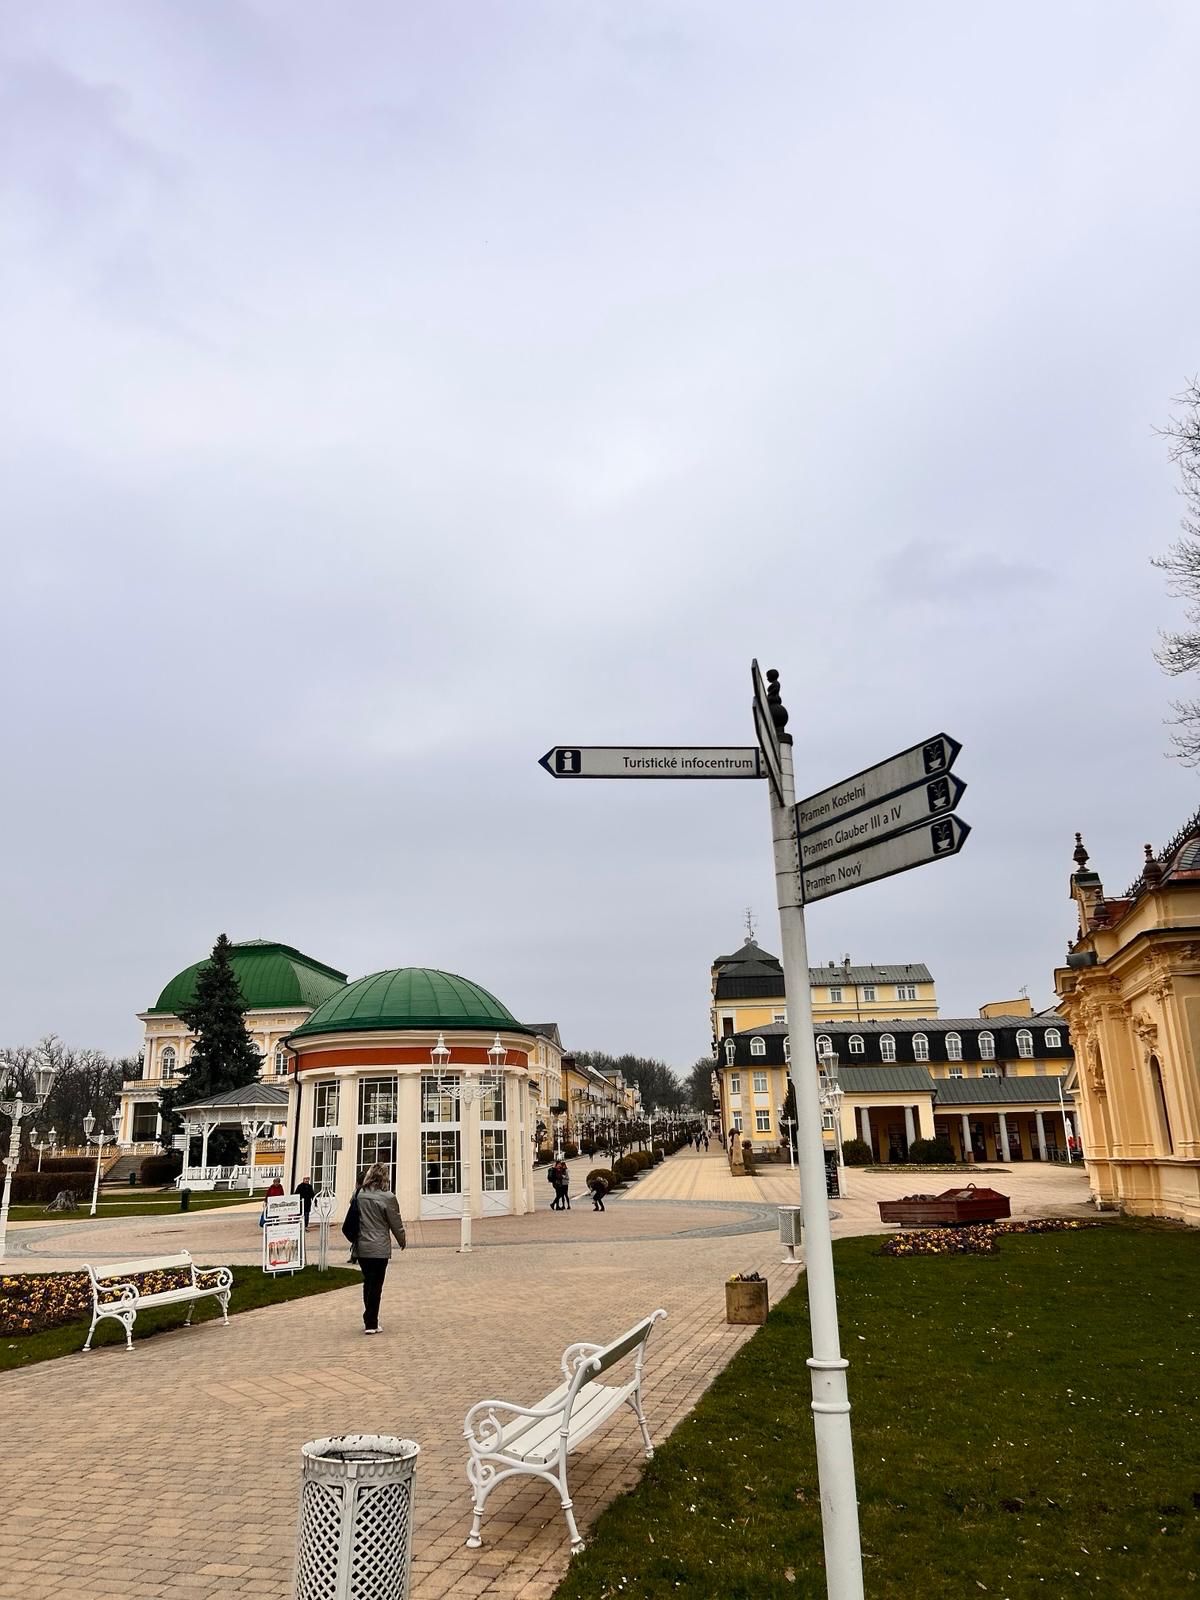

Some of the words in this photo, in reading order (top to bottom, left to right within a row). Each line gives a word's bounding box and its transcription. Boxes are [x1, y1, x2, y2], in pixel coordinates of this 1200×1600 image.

[623, 756, 678, 769] Turistické
[681, 756, 753, 769] infocentrum
[800, 804, 830, 824] Pramen
[832, 784, 865, 809] Kostelní
[803, 838, 833, 857] Pramen
[835, 823, 868, 843] Glauber
[870, 814, 881, 830] III
[883, 814, 889, 825] a
[891, 805, 902, 821] IV
[806, 874, 836, 891] Pramen
[837, 861, 862, 880] Nový
